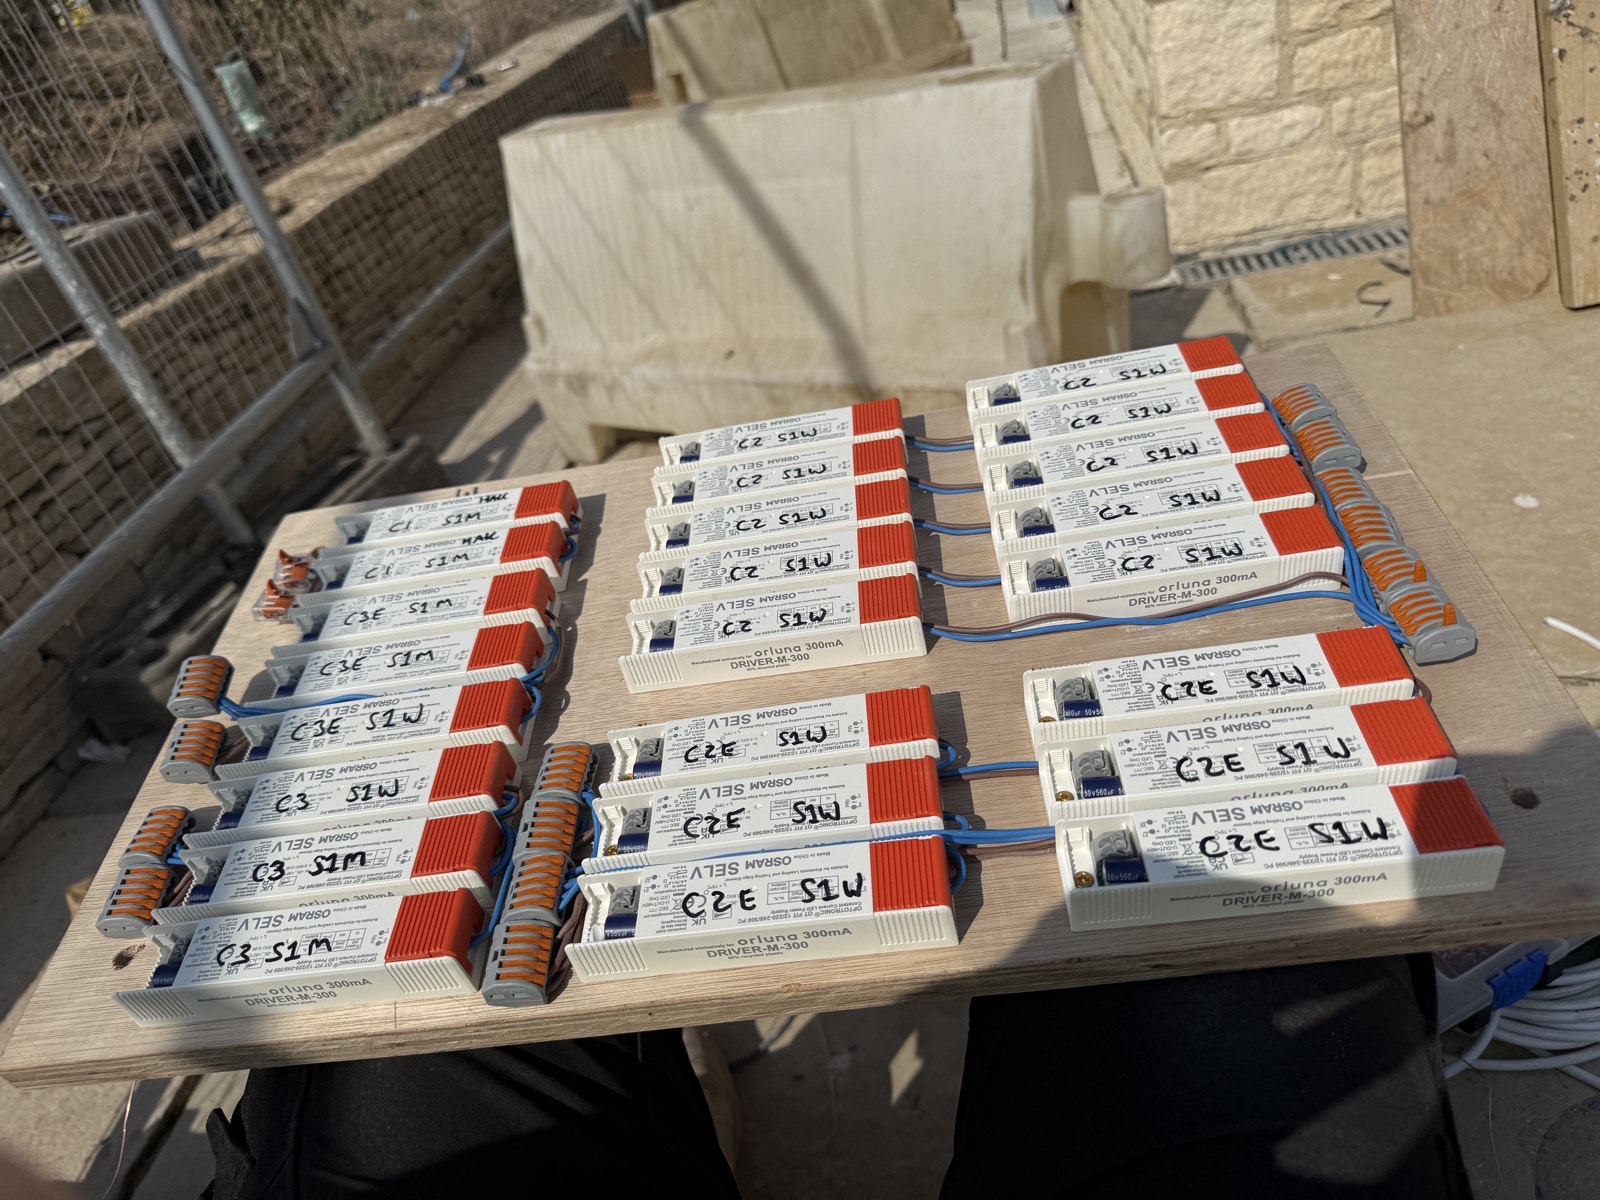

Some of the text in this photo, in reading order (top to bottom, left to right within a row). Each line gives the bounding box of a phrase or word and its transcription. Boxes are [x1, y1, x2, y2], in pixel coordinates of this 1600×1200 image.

[1049, 354, 1123, 373] OSRAM SELV
[1060, 391, 1137, 411] OSRAM SELV
[734, 416, 800, 433] OSRAM SELV
[1073, 430, 1155, 451] OSRAM SELV
[729, 454, 799, 472] OSRAM SELV
[1086, 475, 1173, 497] OSRAM SELV
[404, 497, 472, 513] OSRAM SELV
[726, 495, 799, 514] OSRAM SELV
[386, 538, 457, 557] OSRAM SELV
[1102, 527, 1193, 549] OSRAM SELV
[722, 540, 798, 559] OSRAM SELV
[1158, 572, 1258, 593] orluna 300mA
[366, 586, 441, 605] OSRAM SELV
[715, 591, 796, 612] OSRAM SELV
[1128, 587, 1218, 607] DRIVER-M-300
[342, 638, 421, 658] OSRAM SELV
[754, 645, 801, 657] orluna
[805, 639, 844, 651] 300mA
[730, 653, 810, 669] DRIVER-M-300
[1139, 647, 1241, 671] OSRAM SELV
[319, 696, 400, 718] OSRAM SELV
[707, 705, 797, 730] OSRAM SELV
[1163, 718, 1271, 744] OSRAM SELV
[293, 760, 378, 783] OSRAM SELV
[698, 776, 792, 800] OSRAM SELV
[1187, 799, 1303, 826] OSRAM SELV
[269, 830, 359, 853] OSRAM SELV
[689, 854, 791, 880] OSRAM SELV
[1261, 878, 1327, 893] orluna
[1334, 872, 1388, 886] 300mA
[1222, 888, 1335, 906] DRIVER-M-300
[235, 907, 332, 932] OSRAM SELV
[737, 933, 798, 946] orluna
[803, 927, 853, 939] 300mA
[706, 941, 809, 958] DRIVER-M-300
[269, 978, 373, 995] orluna 300mA
[244, 990, 338, 1006] DRIVER-M-300
